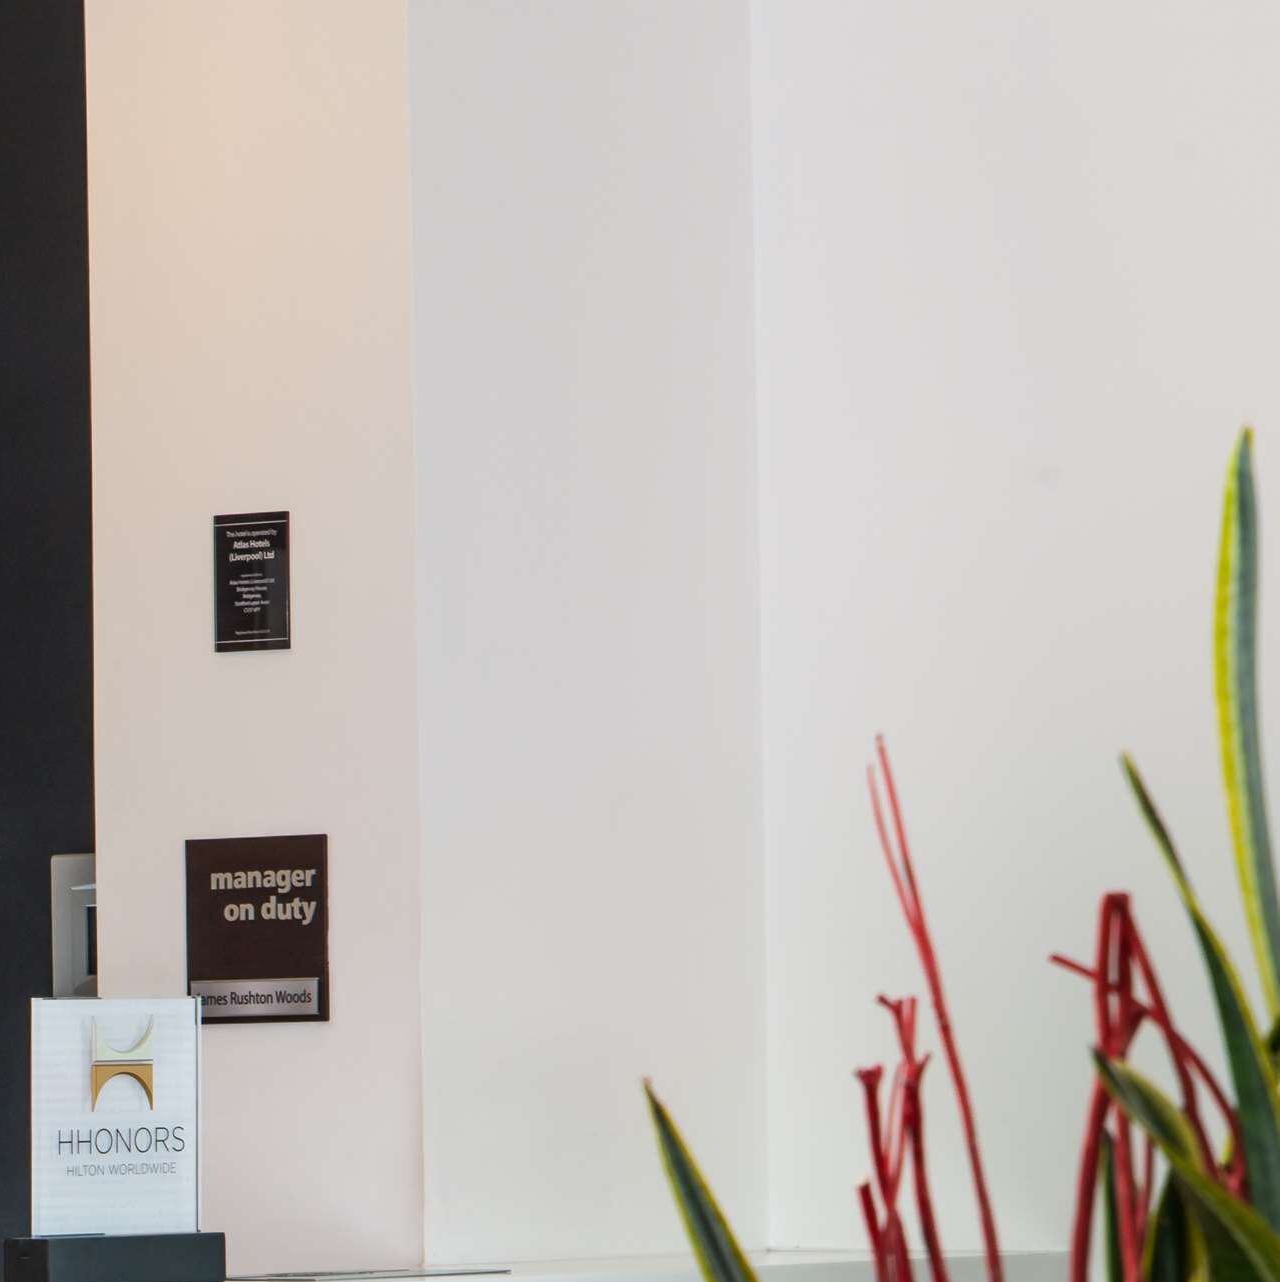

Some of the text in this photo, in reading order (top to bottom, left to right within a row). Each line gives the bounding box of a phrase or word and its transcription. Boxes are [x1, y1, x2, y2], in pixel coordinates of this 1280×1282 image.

[233, 539, 270, 549] Atlas Hotels
[229, 550, 275, 563] (Liverpool) Ltd
[210, 868, 317, 893] manager
[224, 896, 317, 925] on duty
[197, 989, 312, 1006] ames Rushton Woods
[57, 1125, 186, 1156] HHONORS
[66, 1162, 177, 1177] HILTON WORLDWIDE
